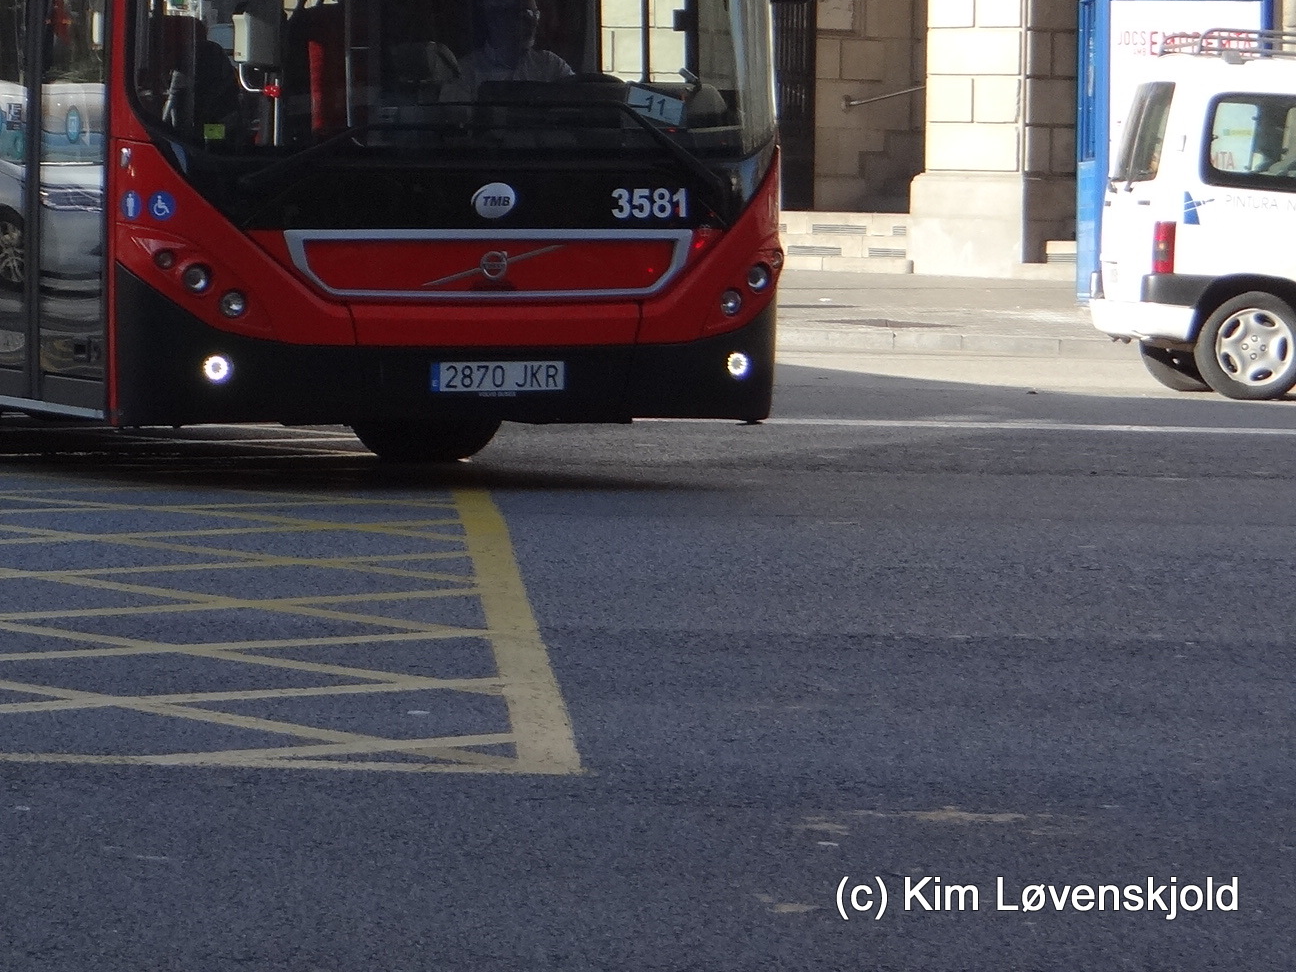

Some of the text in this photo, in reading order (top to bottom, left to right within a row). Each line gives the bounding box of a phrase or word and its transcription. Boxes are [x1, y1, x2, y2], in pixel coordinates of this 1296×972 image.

[1118, 30, 1147, 46] JOCS
[645, 94, 667, 116] 11
[482, 194, 511, 207] TMB
[611, 188, 688, 220] 3581
[1225, 194, 1279, 210] PINTURA
[445, 364, 505, 389] 2870
[515, 364, 559, 388] JKR
